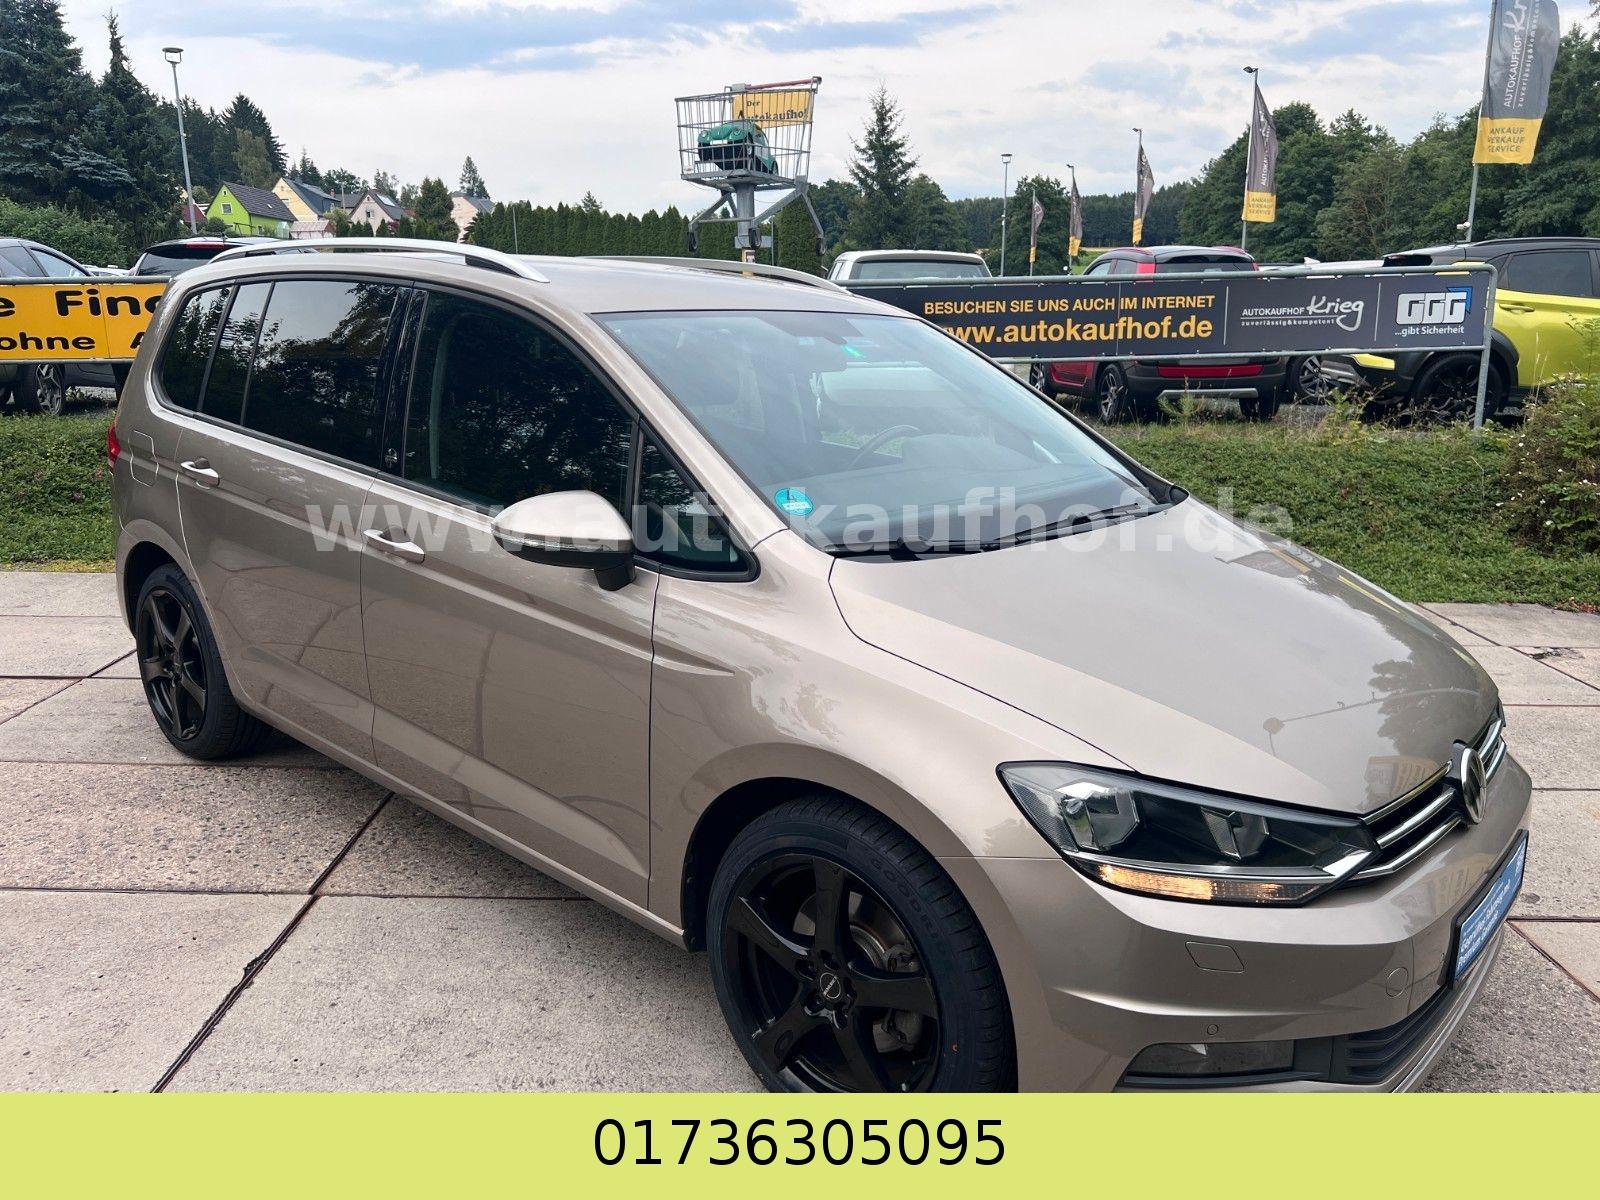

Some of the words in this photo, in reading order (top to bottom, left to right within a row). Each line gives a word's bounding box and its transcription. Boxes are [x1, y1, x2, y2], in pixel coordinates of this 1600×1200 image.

[1490, 127, 1525, 135] ANKAUF
[924, 300, 1006, 315] BESUCHEN
[1010, 299, 1033, 313] SIE
[1037, 298, 1069, 313] UNS
[1073, 297, 1115, 311] AUCH
[1120, 296, 1138, 311] IM
[1141, 295, 1216, 310] INTERNET
[1242, 307, 1305, 316] AUTOKAUFHOF
[1306, 295, 1365, 332] Krieg
[1396, 292, 1468, 325] GGG
[942, 314, 1213, 344] ww.autokaufhof.de
[1421, 325, 1465, 335] Sicherheit
[0, 331, 96, 351] ohne
